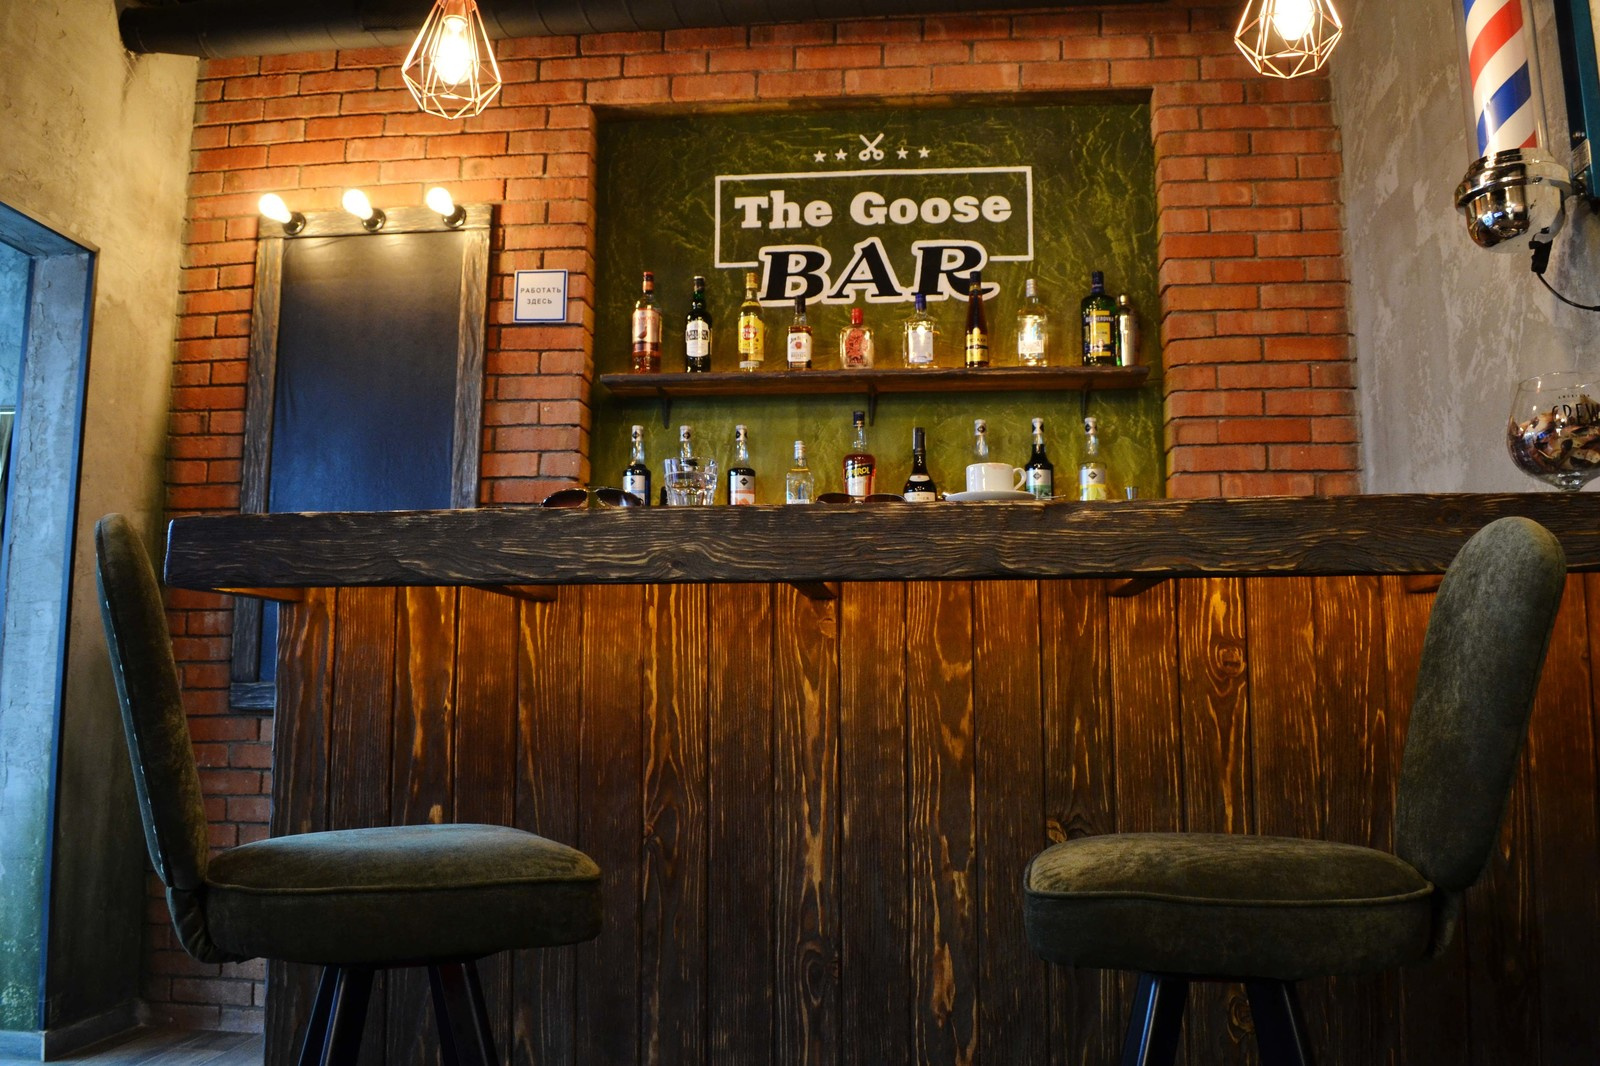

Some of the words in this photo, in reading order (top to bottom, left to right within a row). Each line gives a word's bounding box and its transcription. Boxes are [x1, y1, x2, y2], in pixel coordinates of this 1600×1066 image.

[734, 190, 833, 229] The
[850, 191, 1013, 226] Goose
[755, 236, 1001, 307] BAR
